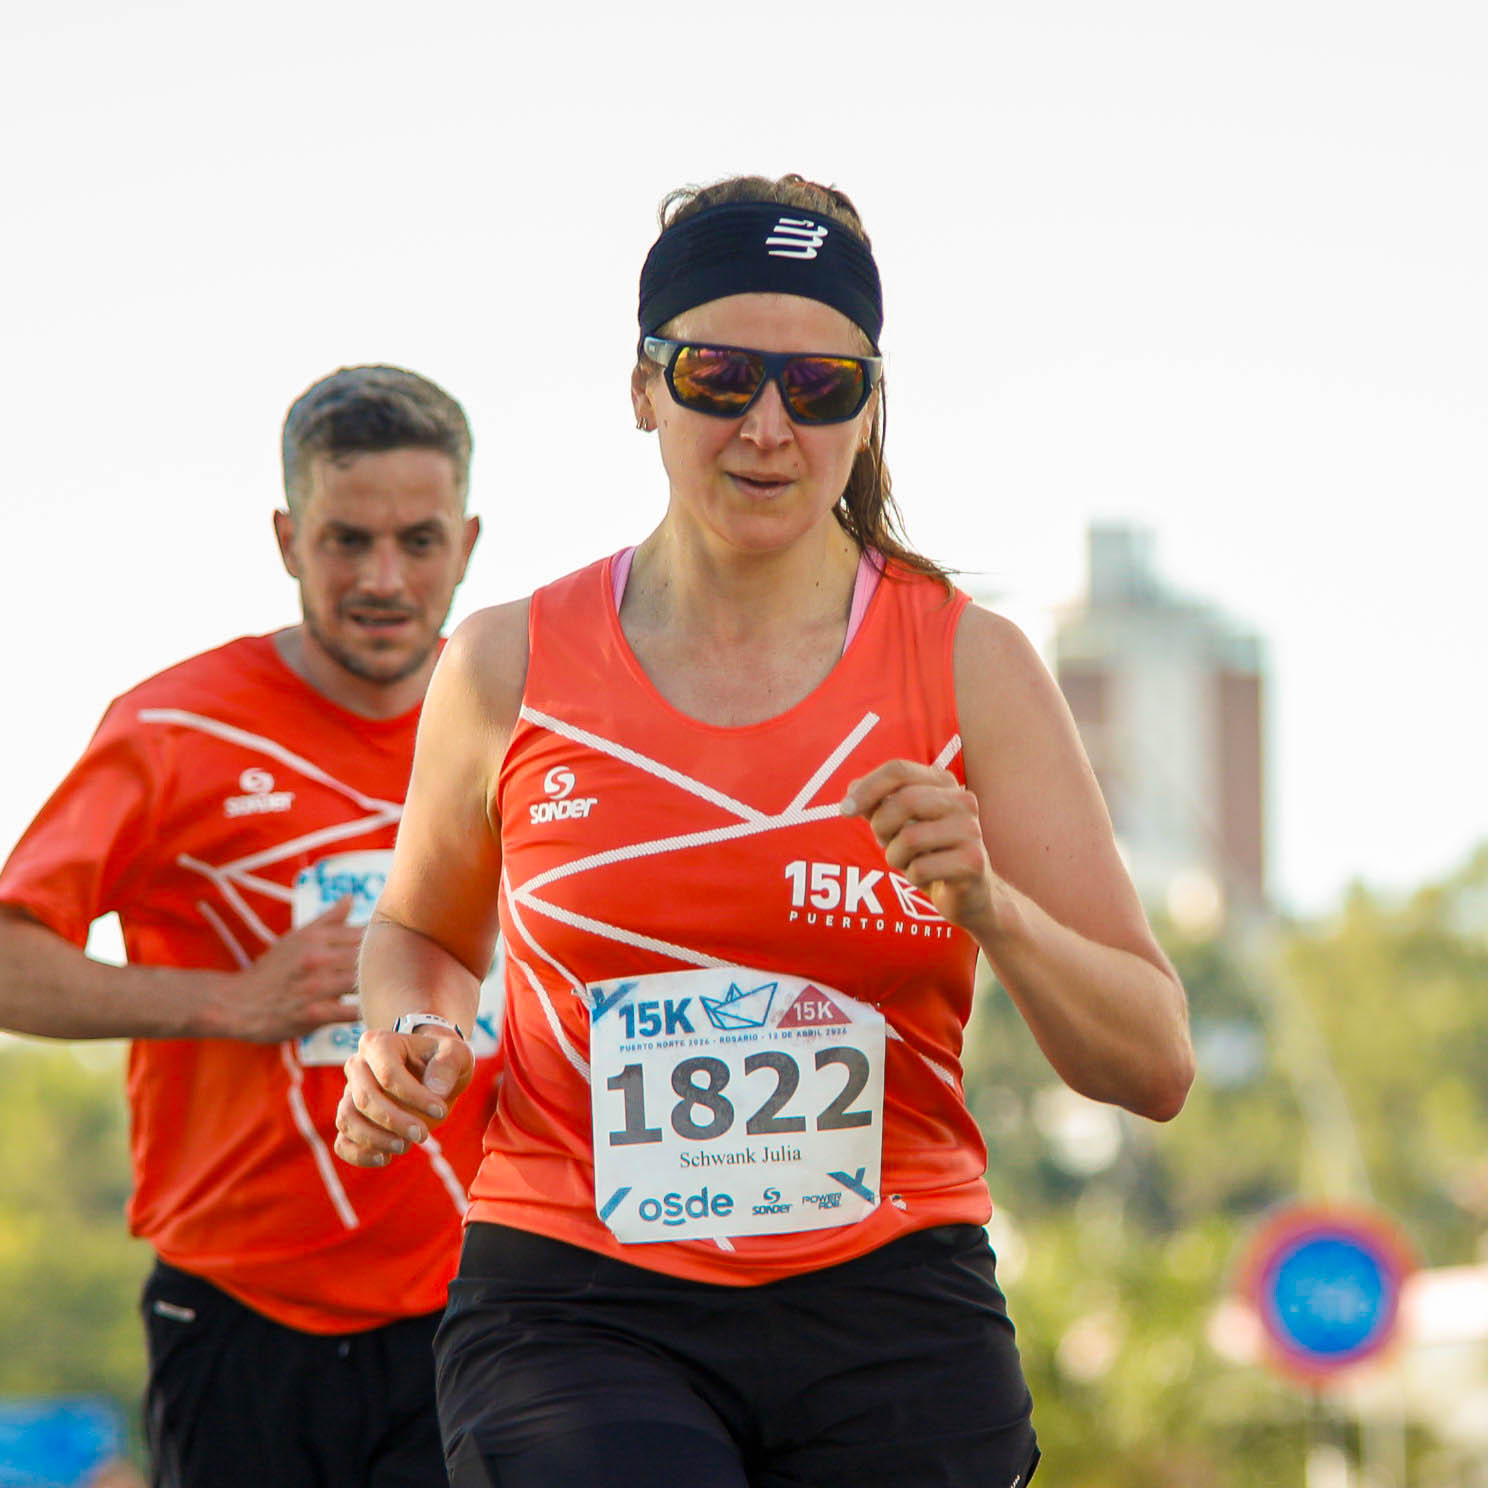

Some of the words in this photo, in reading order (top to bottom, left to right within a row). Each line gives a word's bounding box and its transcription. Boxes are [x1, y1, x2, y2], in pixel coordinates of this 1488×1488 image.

[784, 860, 885, 915] 15K
[789, 910, 885, 931] PUERTO
[895, 920, 953, 939] NORTE
[619, 997, 696, 1040] 15K
[793, 1001, 833, 1021] 15K
[619, 1043, 653, 1052] PUERTO
[656, 1038, 685, 1049] NORTE
[719, 1034, 758, 1043] ROSARIO
[781, 1031, 792, 1039] DE
[796, 1028, 822, 1037] ABRIL
[607, 1047, 872, 1146] 1822
[680, 1149, 757, 1169] Schwank
[762, 1145, 801, 1163] Julia
[639, 1186, 734, 1226] osde
